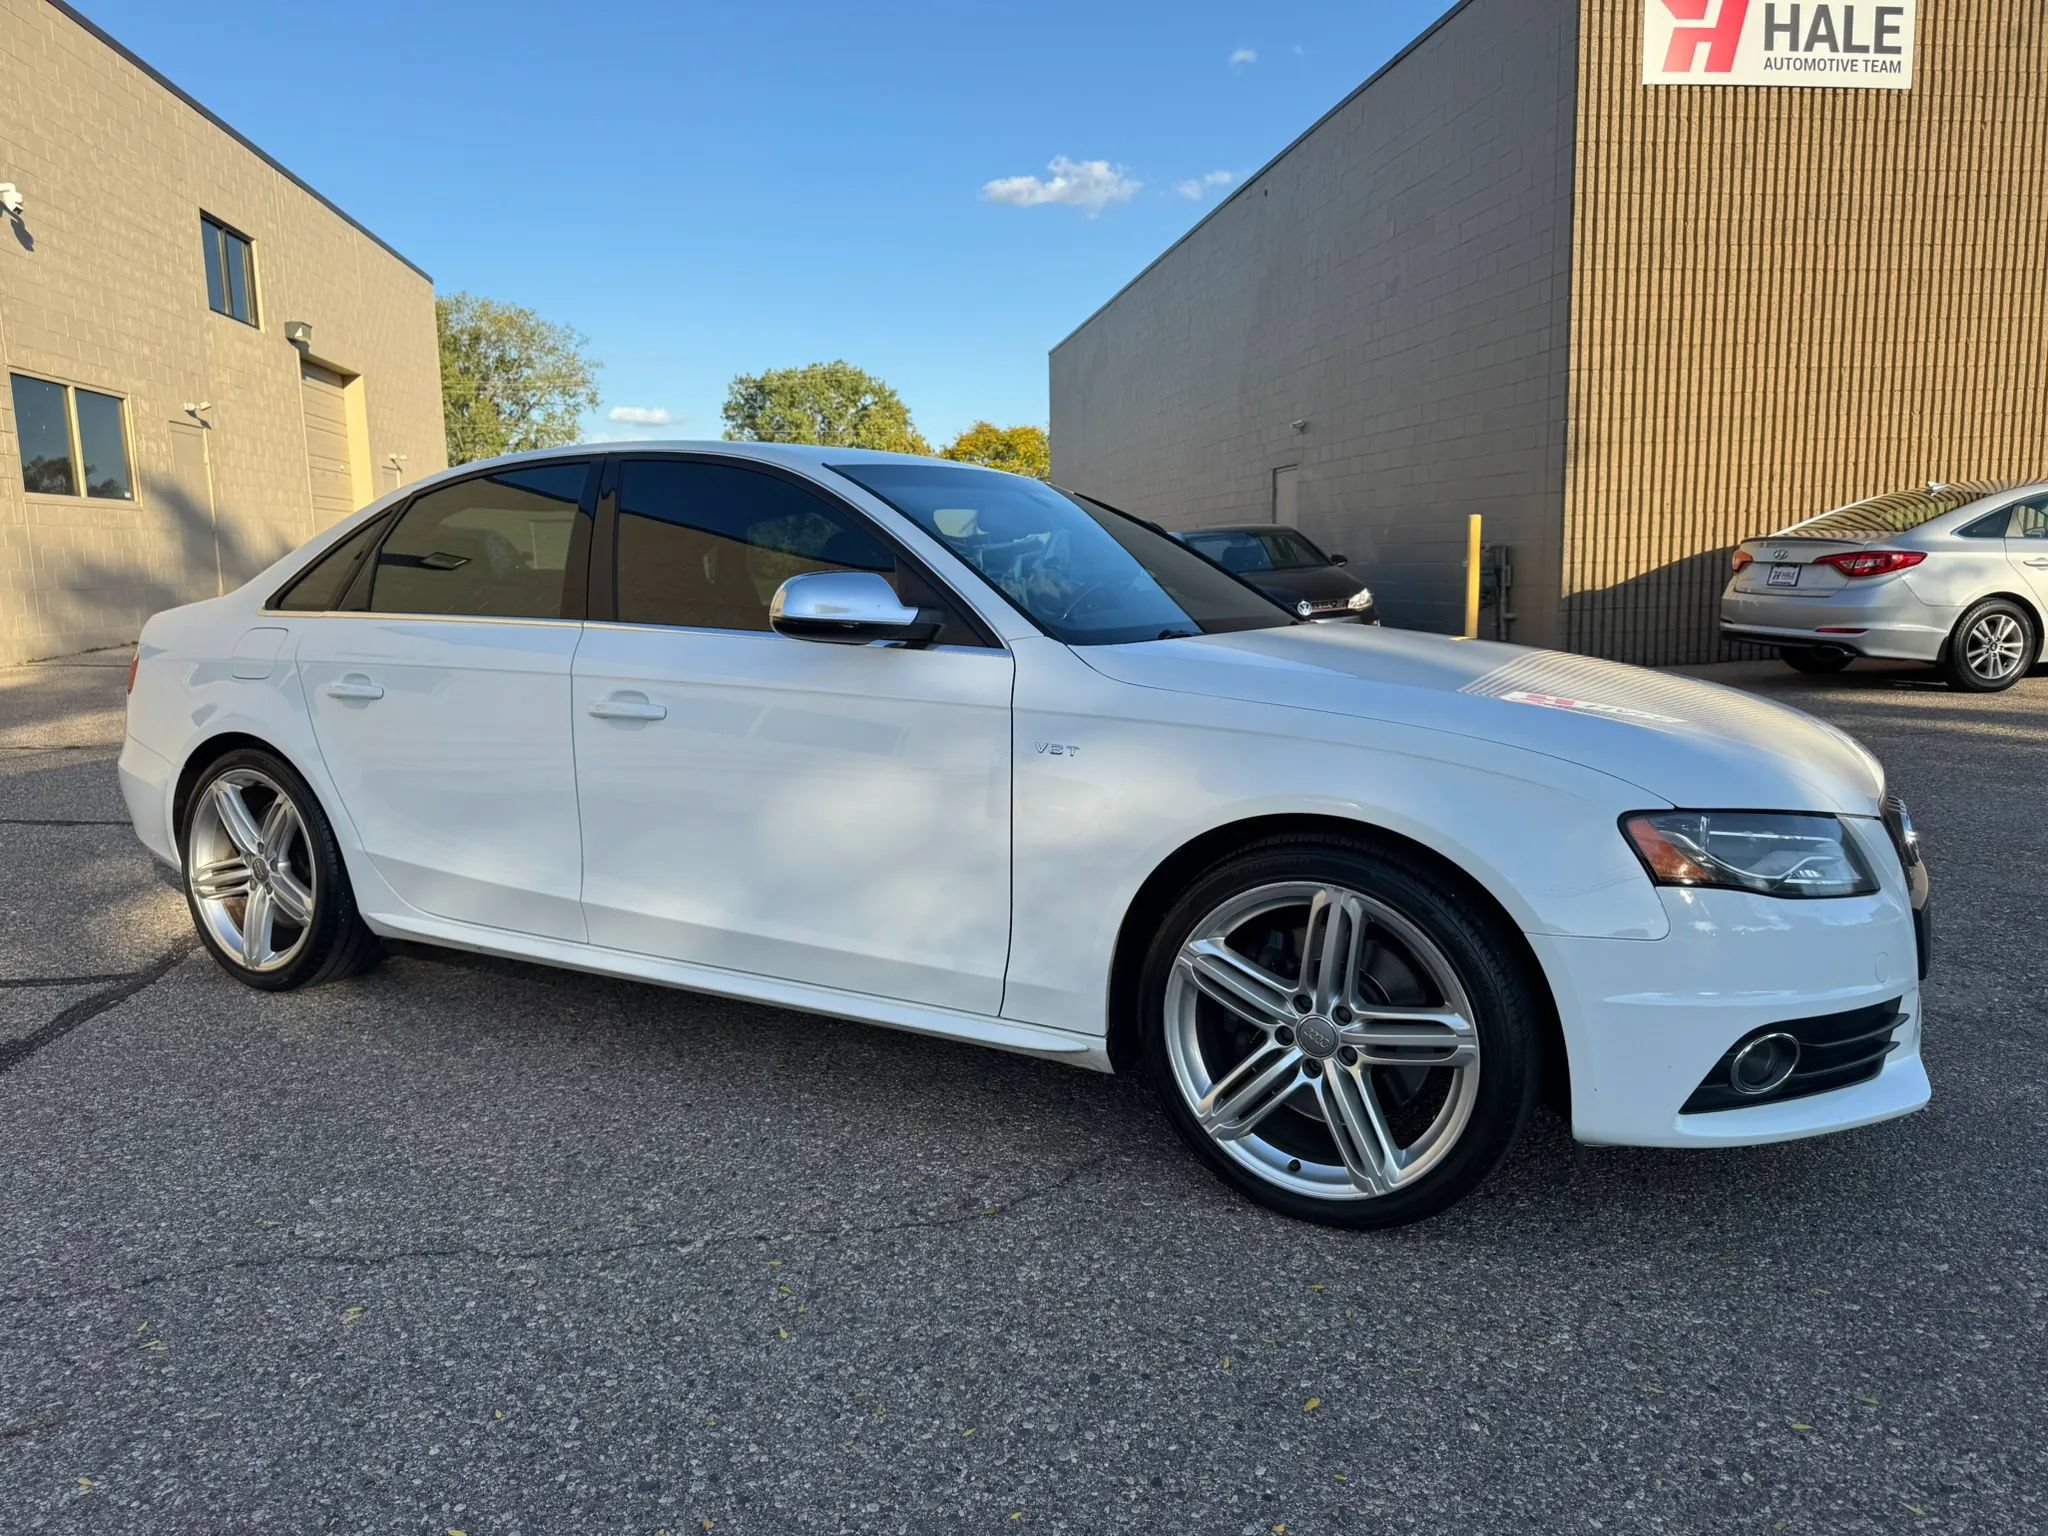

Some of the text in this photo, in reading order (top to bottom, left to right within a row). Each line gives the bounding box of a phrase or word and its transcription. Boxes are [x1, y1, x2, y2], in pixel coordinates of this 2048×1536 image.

[1764, 3, 1904, 54] HALE
[1763, 56, 1902, 74] AUTOMOTIVE TEAM
